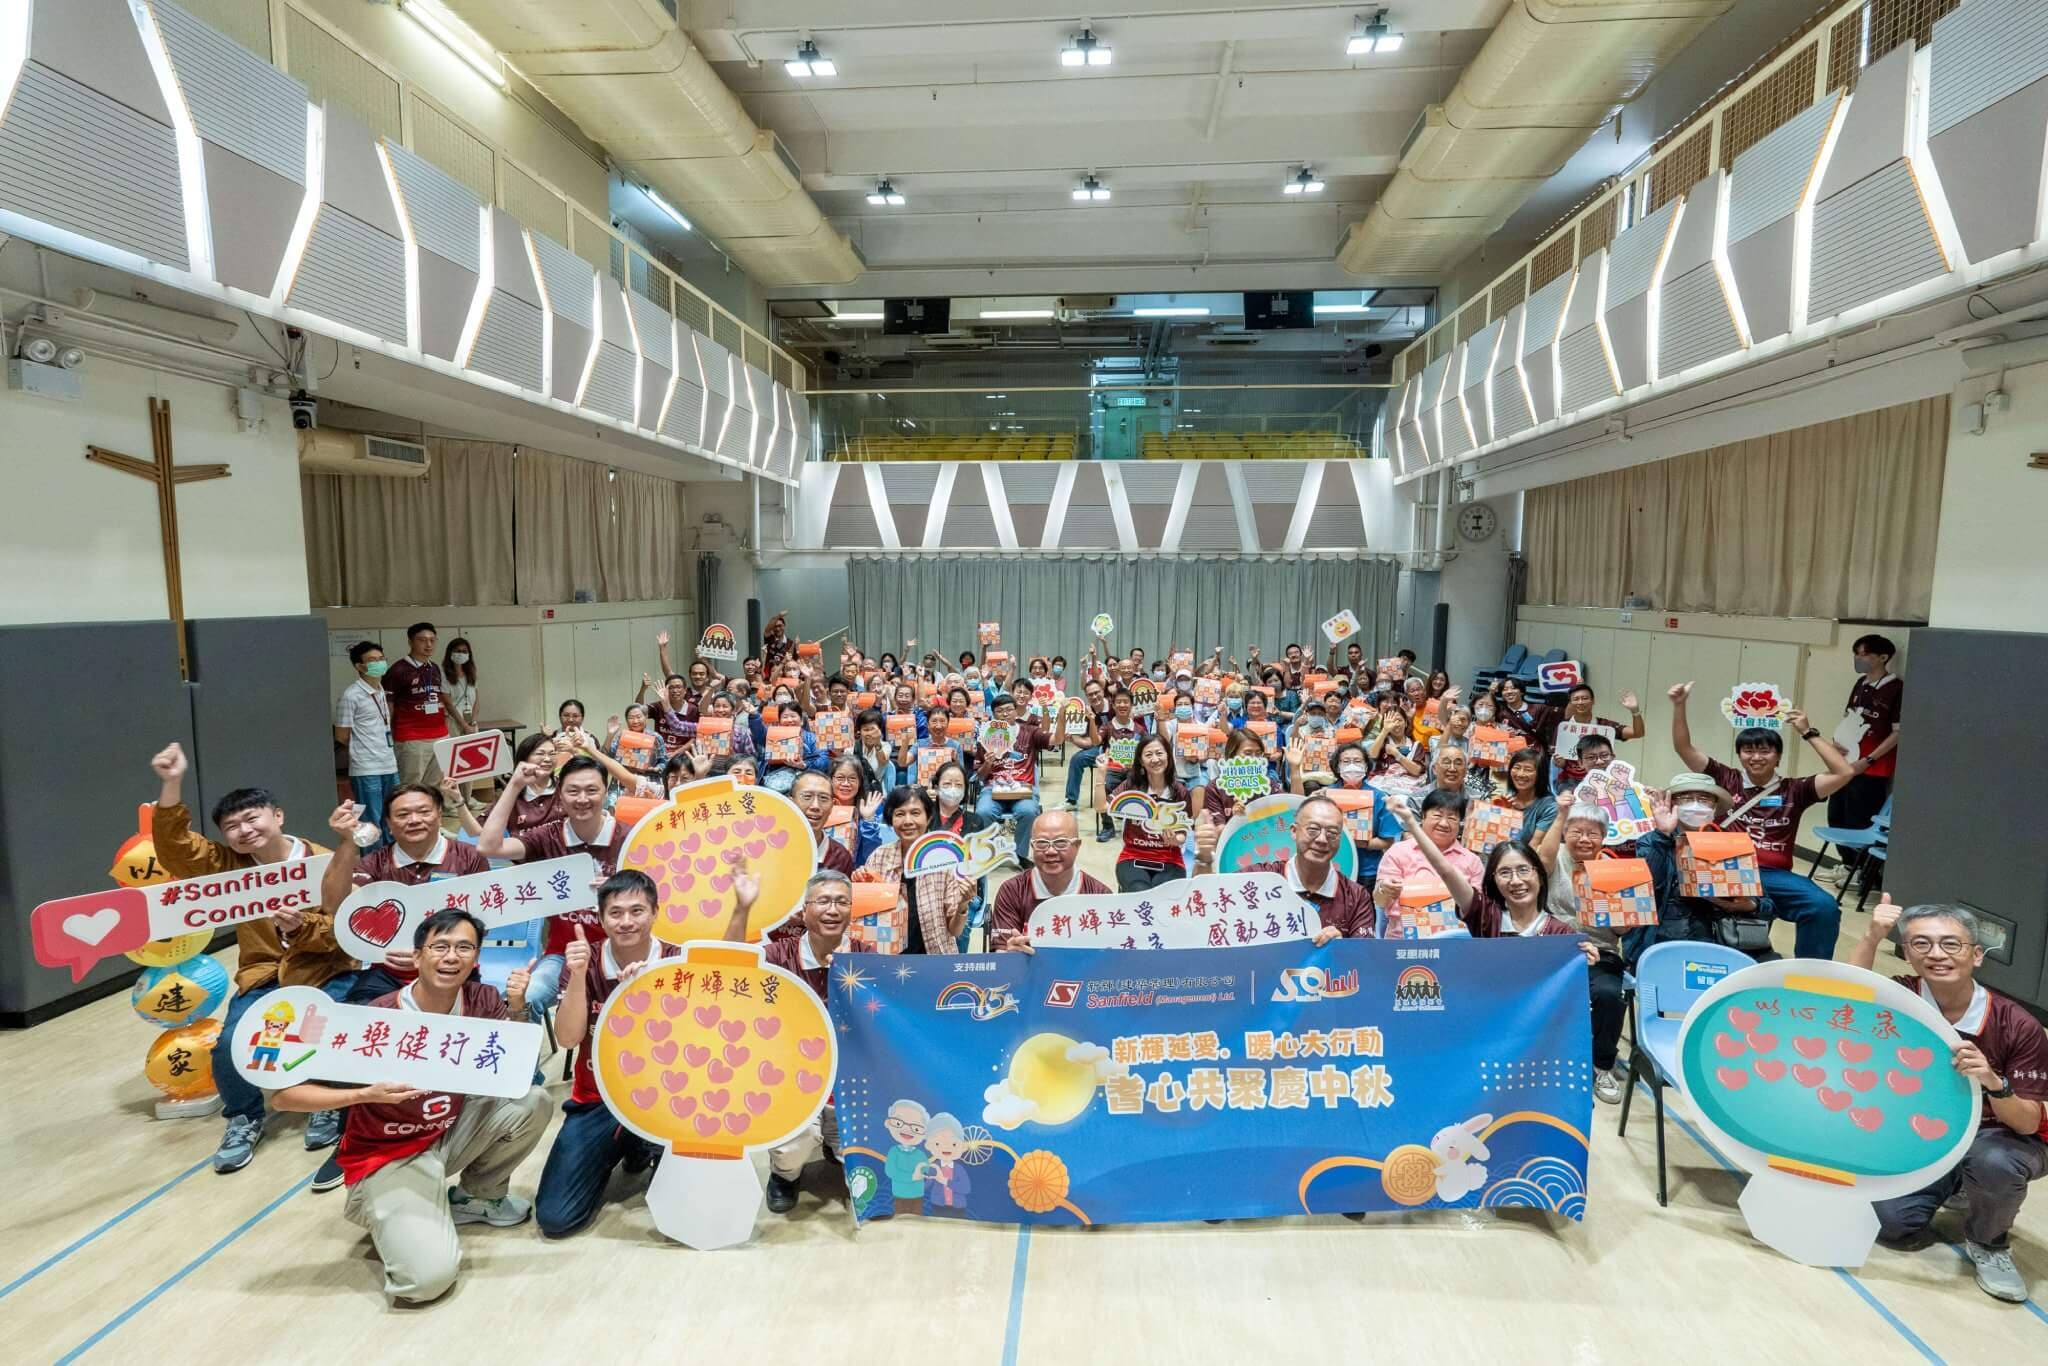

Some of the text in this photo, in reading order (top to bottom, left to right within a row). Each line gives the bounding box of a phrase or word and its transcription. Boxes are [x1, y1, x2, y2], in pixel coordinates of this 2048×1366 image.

[1733, 715, 1780, 728] 社會共融
[1228, 777, 1260, 788] GOALS
[160, 863, 307, 906] #Sanfield
[183, 888, 311, 928] Connect
[1035, 901, 1155, 938] #新輝延愛
[1207, 907, 1307, 946] 感動每刻
[1087, 991, 1153, 1009] Sanfield
[1245, 1027, 1383, 1059] 暖心大行動
[1105, 1065, 1394, 1114] 耆心共聚慶中秋
